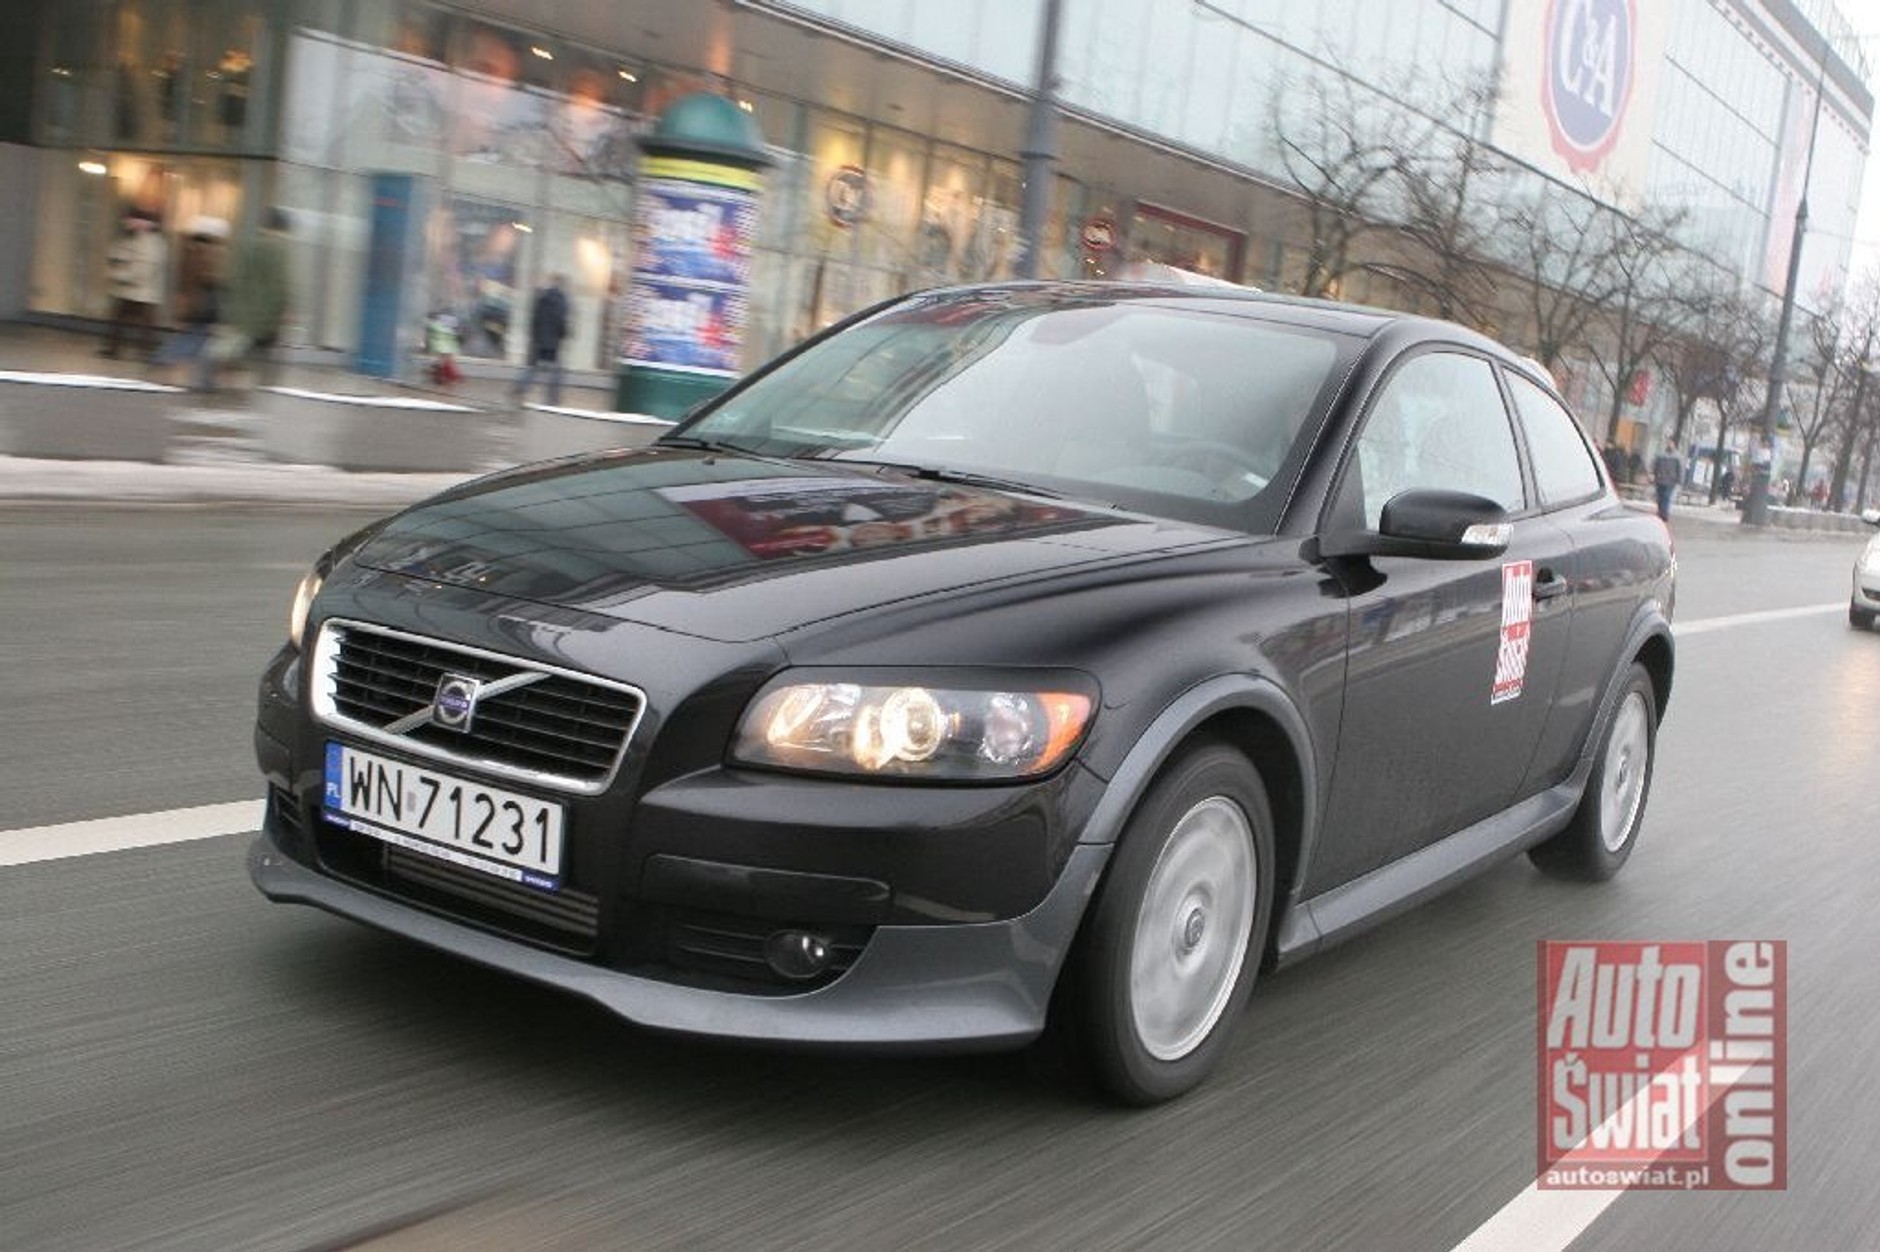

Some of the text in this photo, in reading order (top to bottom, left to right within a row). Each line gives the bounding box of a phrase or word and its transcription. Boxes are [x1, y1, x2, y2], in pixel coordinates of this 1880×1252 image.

[1559, 0, 1618, 118] C&A
[326, 782, 340, 798] PL
[350, 756, 549, 864] WN 71231
